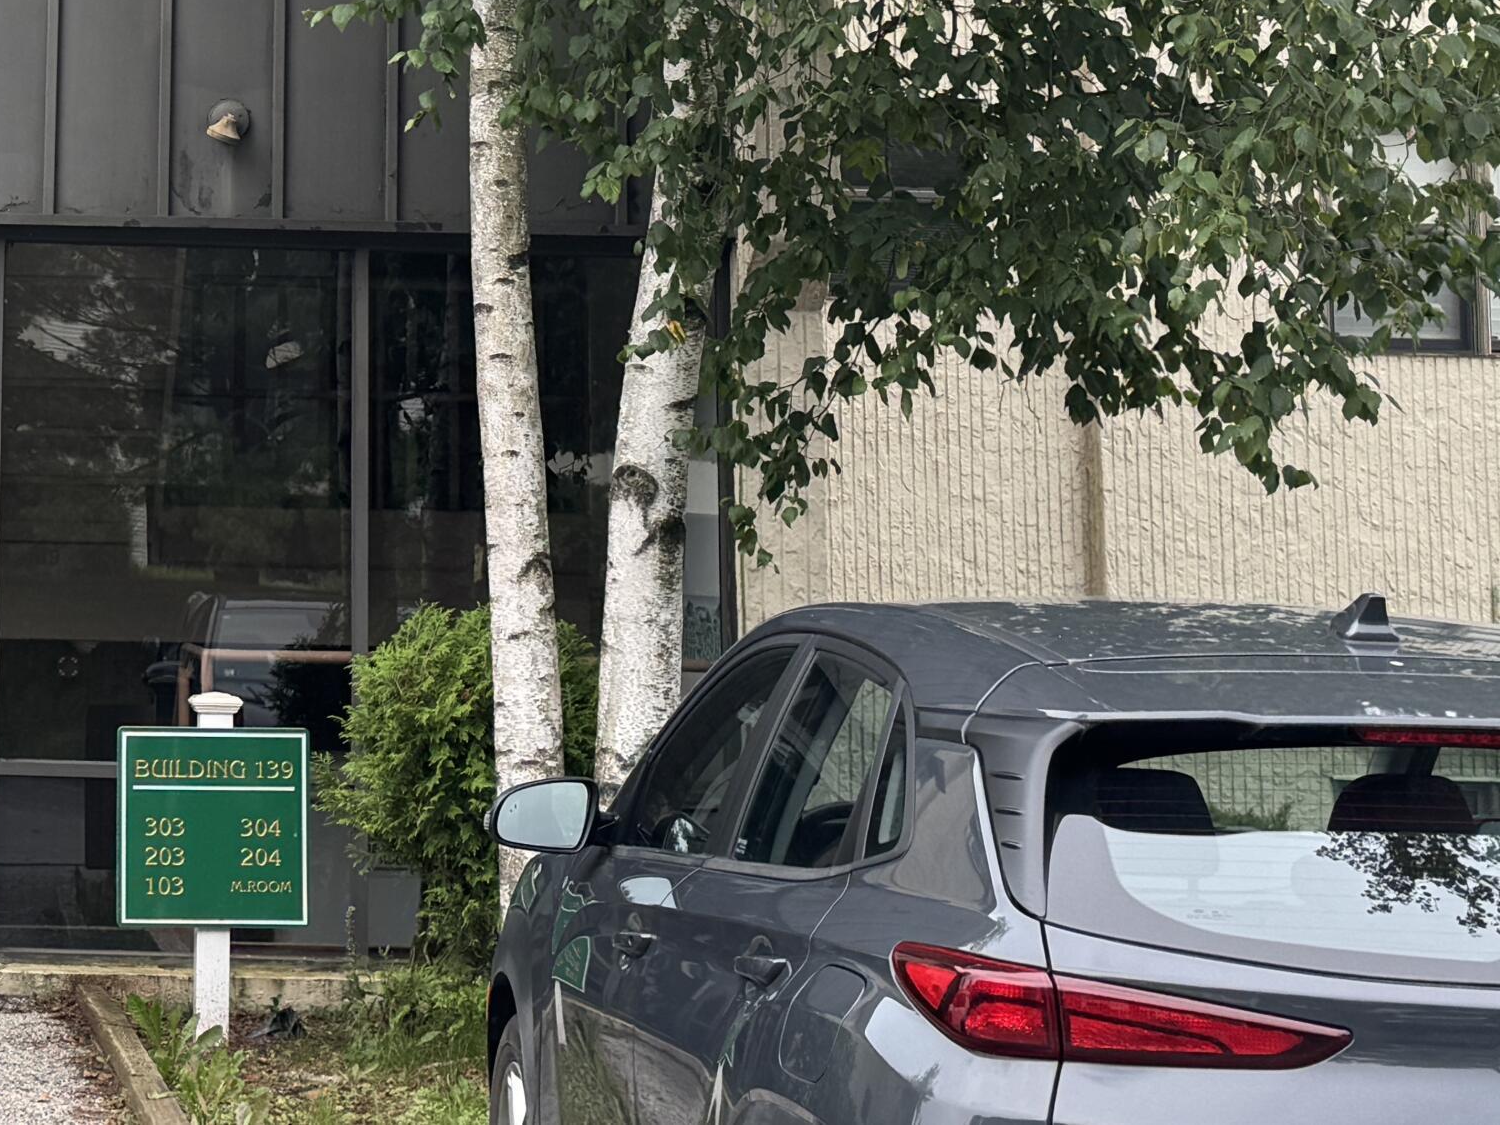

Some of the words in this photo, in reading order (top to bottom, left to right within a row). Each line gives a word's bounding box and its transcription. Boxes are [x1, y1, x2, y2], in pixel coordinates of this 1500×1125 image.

[134, 759, 246, 779] BUILDING
[255, 760, 295, 779] 139
[145, 817, 185, 837] 303
[240, 818, 282, 837] 304
[145, 847, 185, 866] 203
[240, 848, 282, 867] 204
[145, 876, 185, 896] 103
[230, 880, 293, 893] M.ROOM
